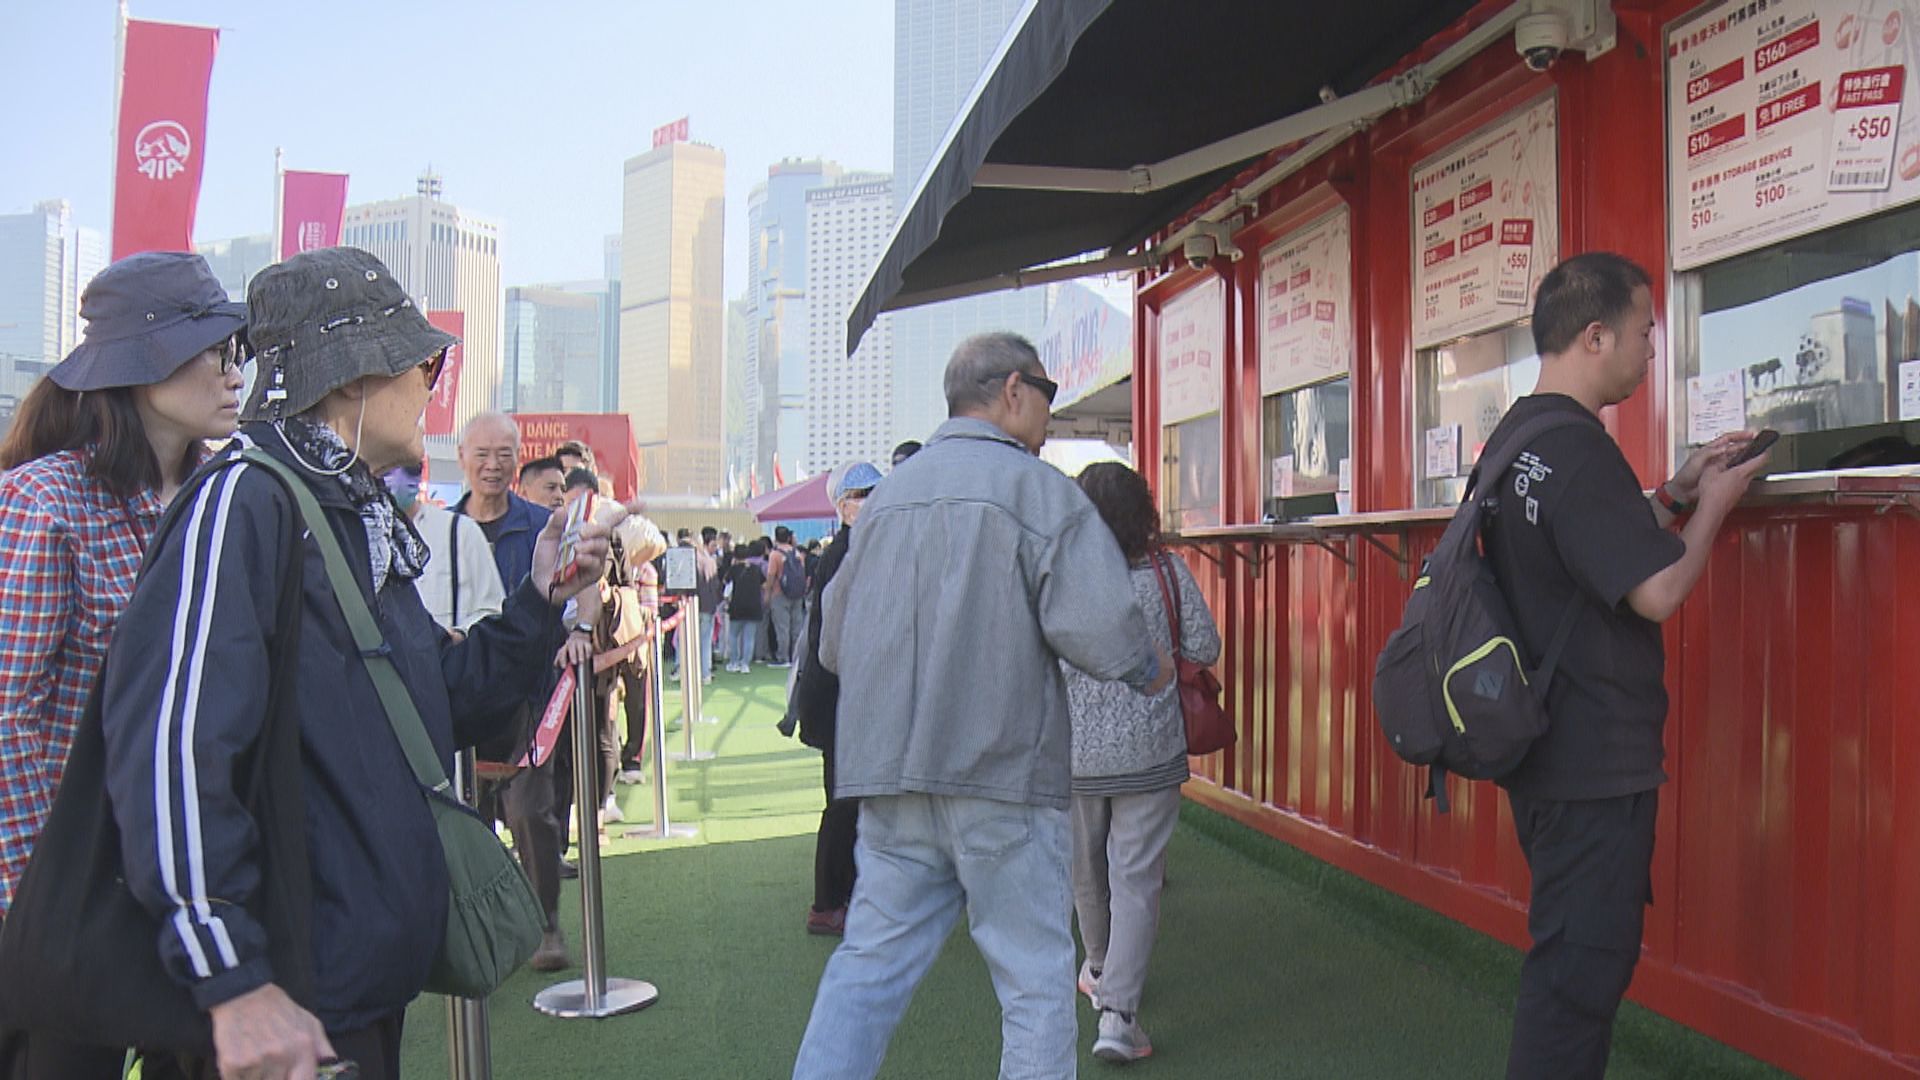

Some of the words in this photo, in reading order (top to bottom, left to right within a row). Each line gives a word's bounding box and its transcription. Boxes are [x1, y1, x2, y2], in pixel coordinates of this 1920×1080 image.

[1757, 42, 1786, 69] $160
[1689, 78, 1710, 100] $20
[1841, 91, 1862, 103] FAST
[1862, 88, 1885, 102] PASS
[1782, 94, 1808, 114] FREE
[1848, 116, 1891, 141] +$50
[1690, 134, 1710, 154] $10
[138, 158, 185, 180] AIA
[1722, 160, 1757, 181] STORAGE
[1759, 146, 1793, 168] SERVICE
[847, 184, 885, 197] AMERICA
[1755, 184, 1785, 208] $100
[1691, 209, 1711, 229] $10
[526, 421, 569, 438] DANCE
